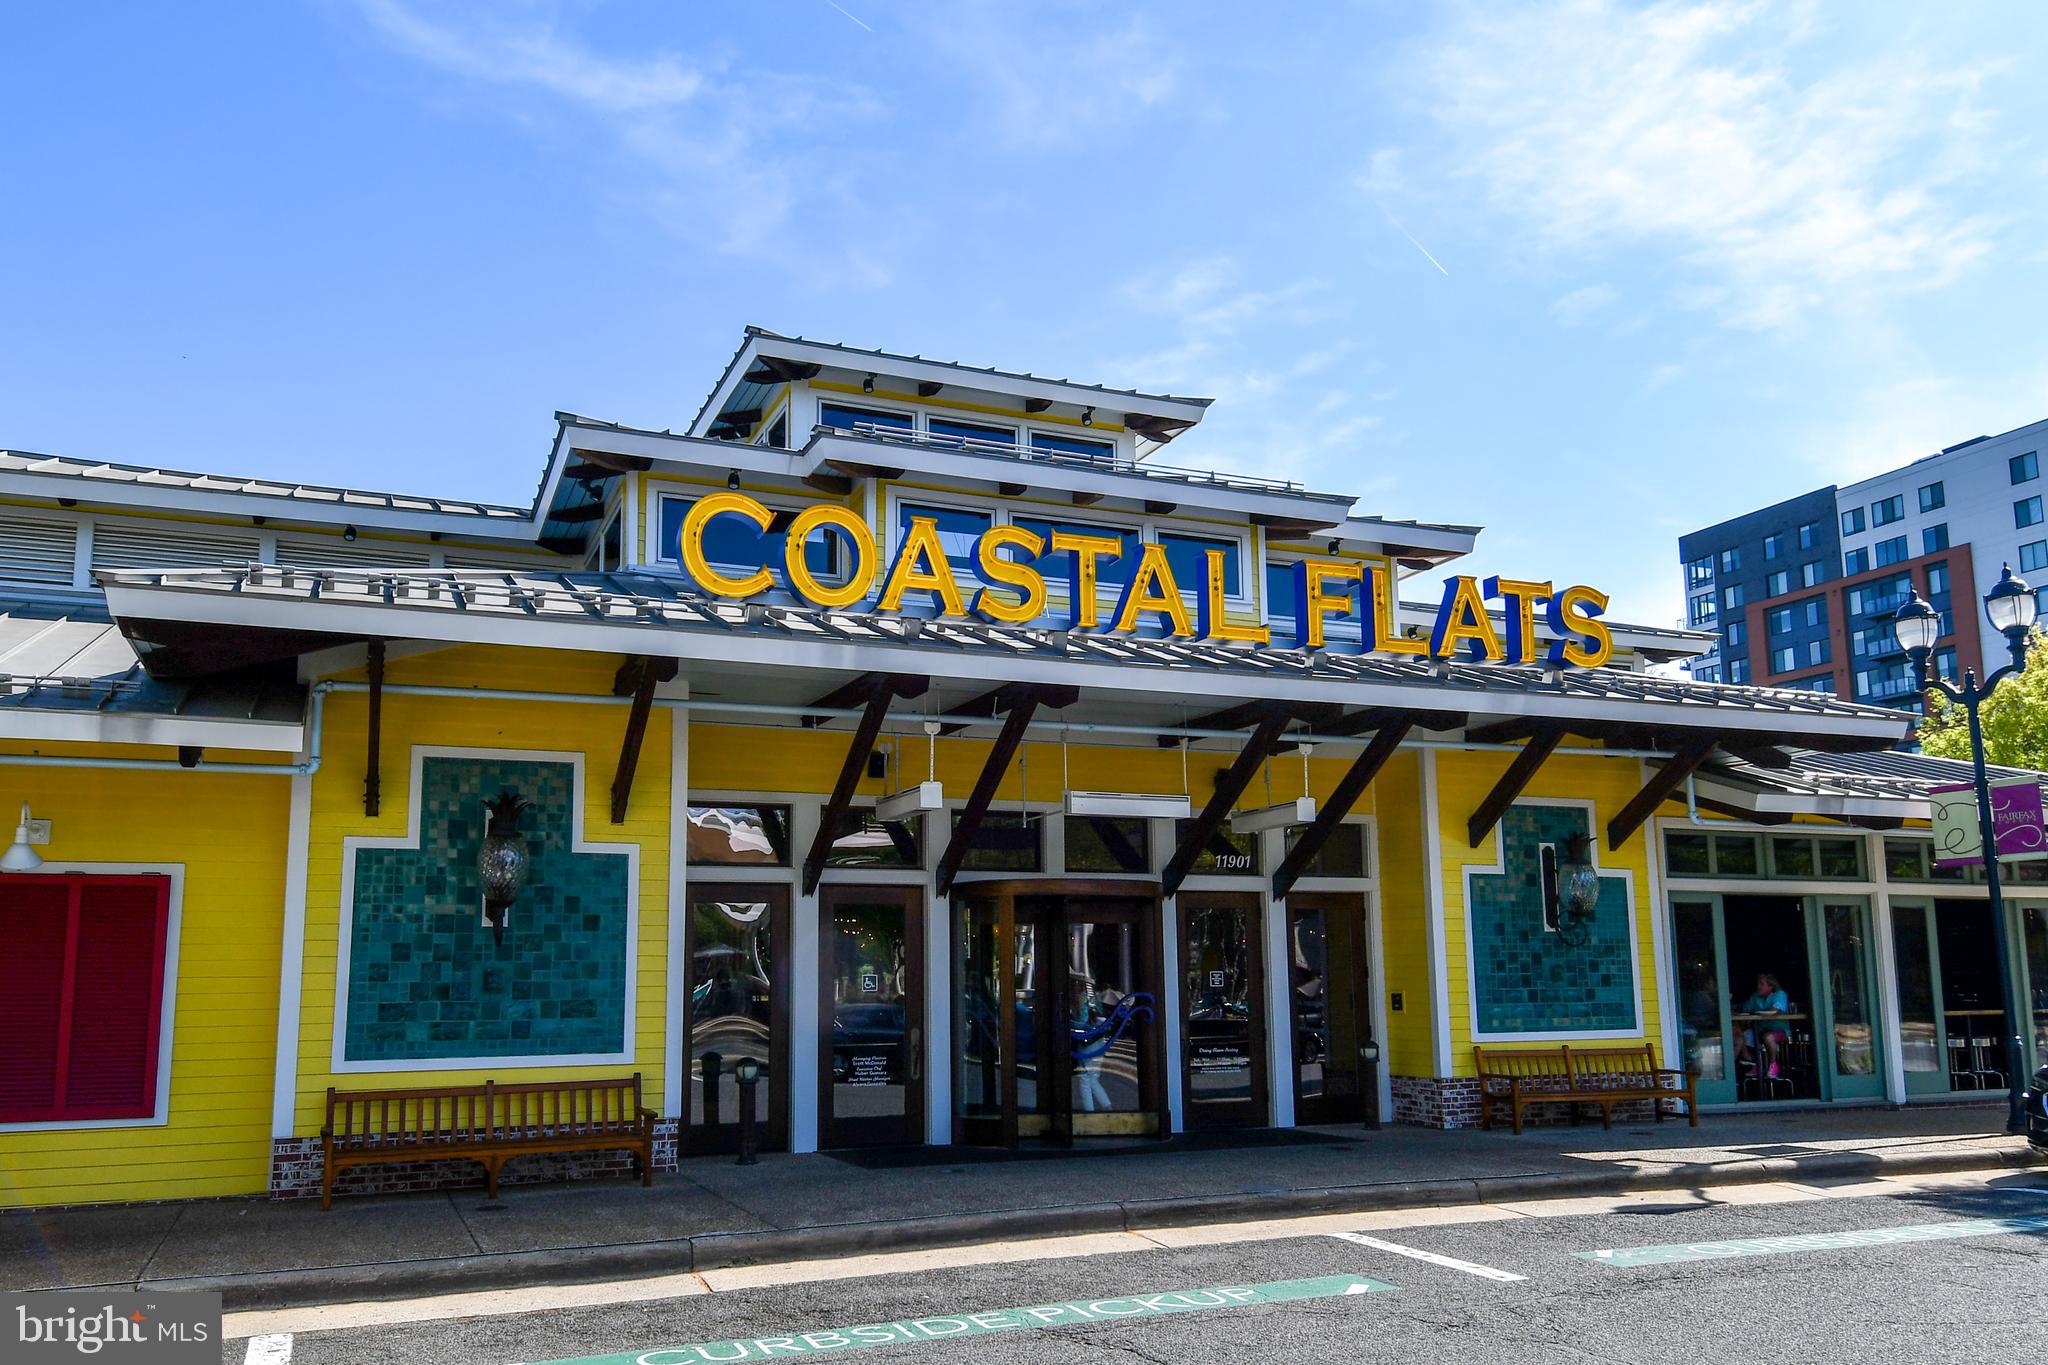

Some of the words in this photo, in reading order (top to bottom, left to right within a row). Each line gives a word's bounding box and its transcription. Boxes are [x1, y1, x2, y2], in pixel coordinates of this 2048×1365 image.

[676, 491, 1270, 645] COASTAL
[1294, 558, 1612, 670] FLATS
[1998, 810, 2037, 822] FAIRFAX
[1215, 854, 1251, 868] 11901
[636, 1311, 1021, 1365] CURBSIDE
[1027, 1287, 1255, 1323] PICKUP
